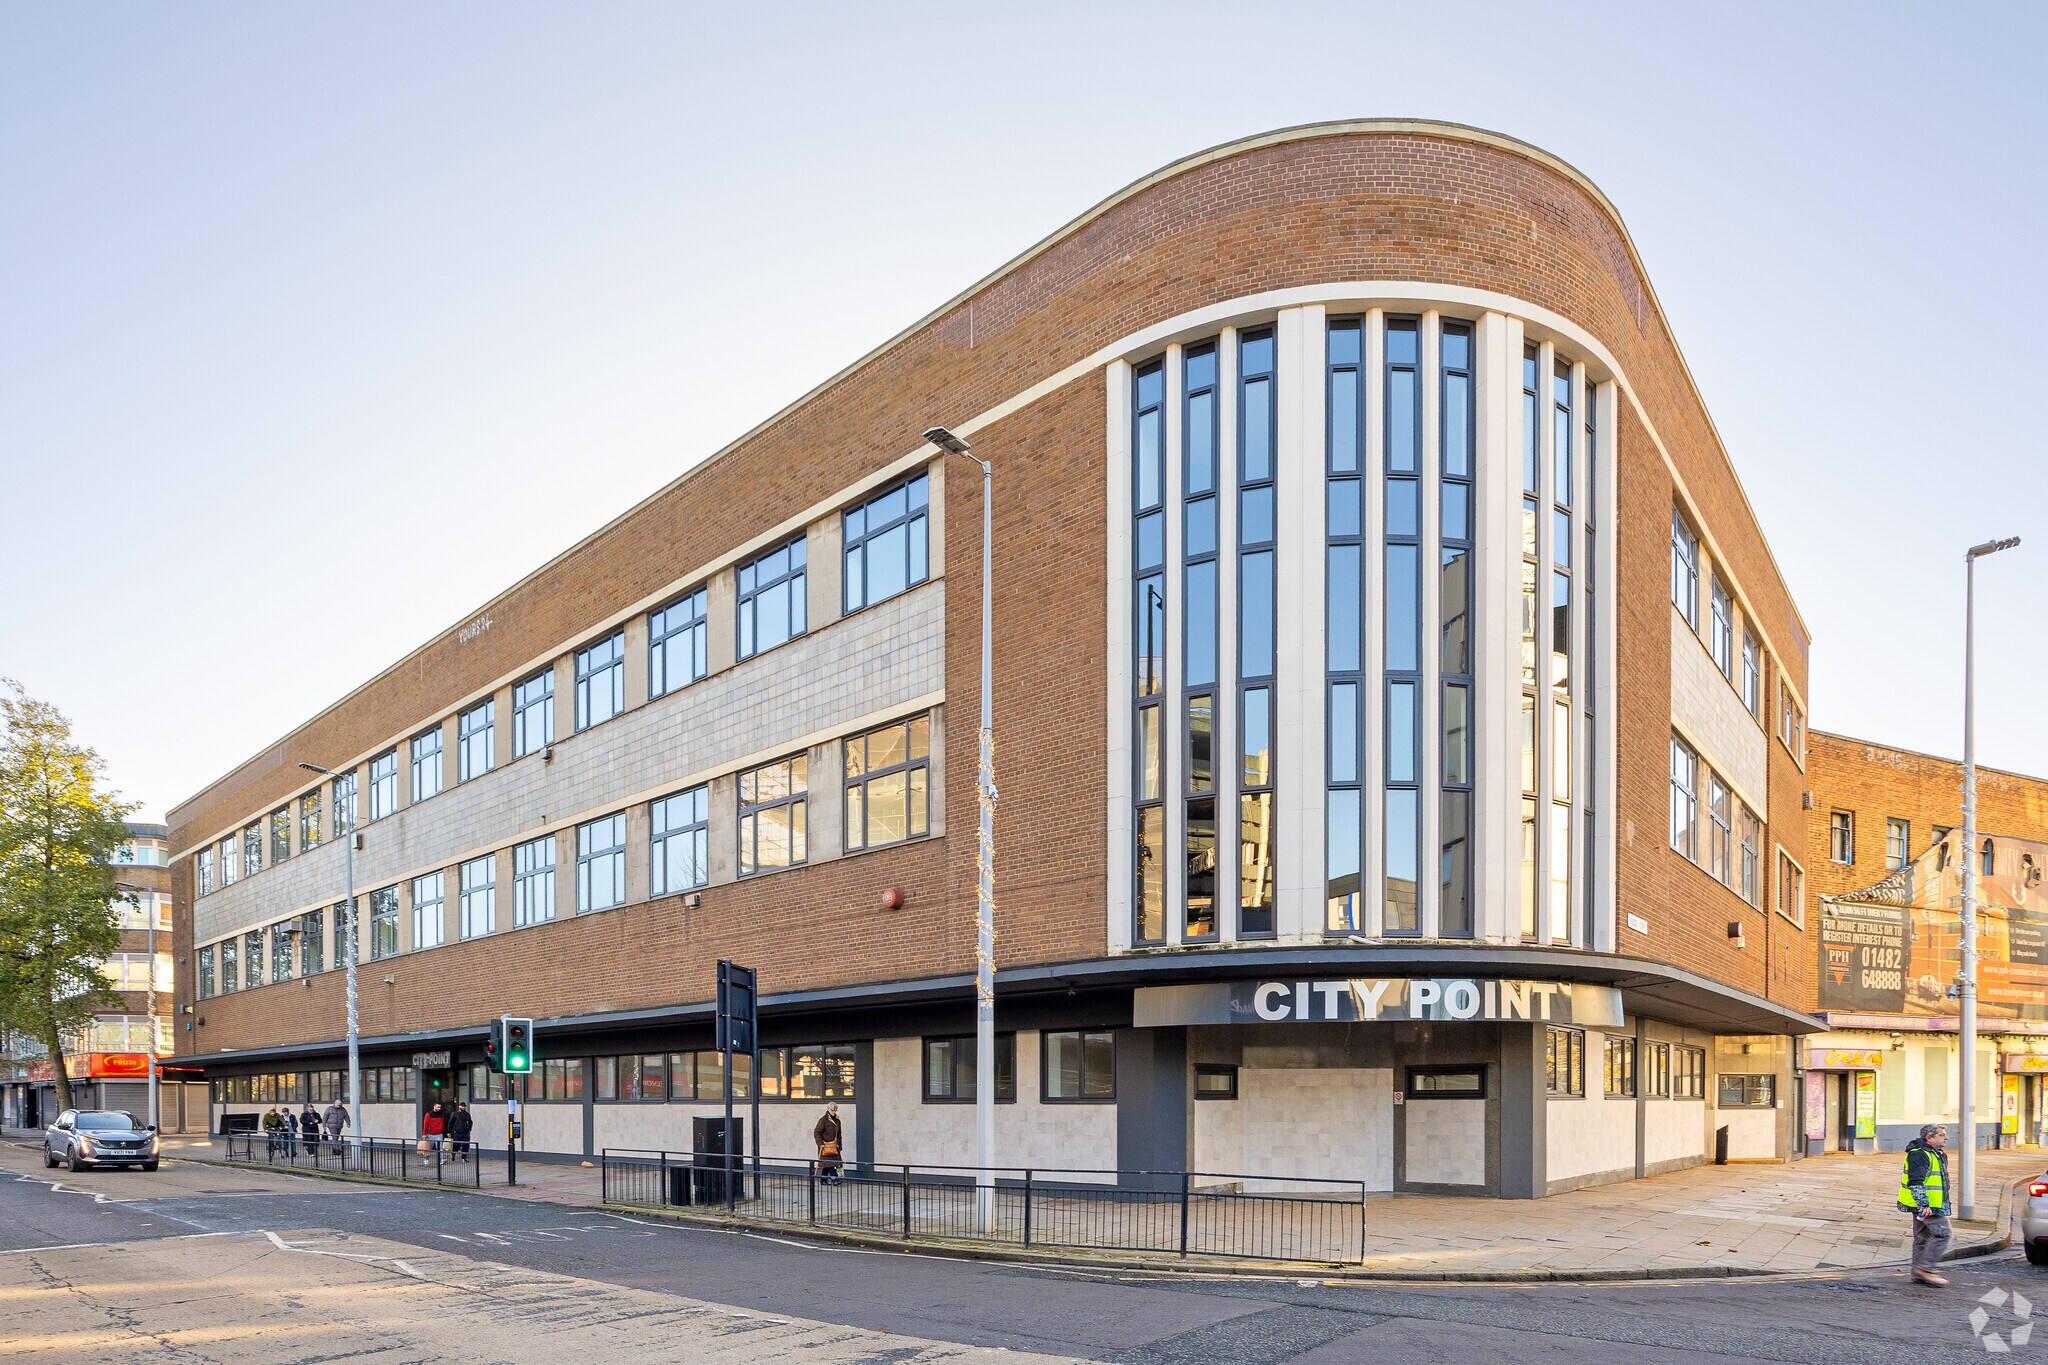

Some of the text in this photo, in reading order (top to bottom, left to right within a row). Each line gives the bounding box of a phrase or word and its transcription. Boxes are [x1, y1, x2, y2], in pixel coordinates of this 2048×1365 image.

[1823, 919, 1903, 936] FOR MORE DETAILS OR TO
[1823, 931, 1903, 948] REGISTER INTEREST PHONE
[1829, 949, 1849, 963] PPH
[1862, 946, 1902, 969] 01482
[1862, 969, 1902, 990] 648888
[1253, 980, 1558, 1021] CITY POINT
